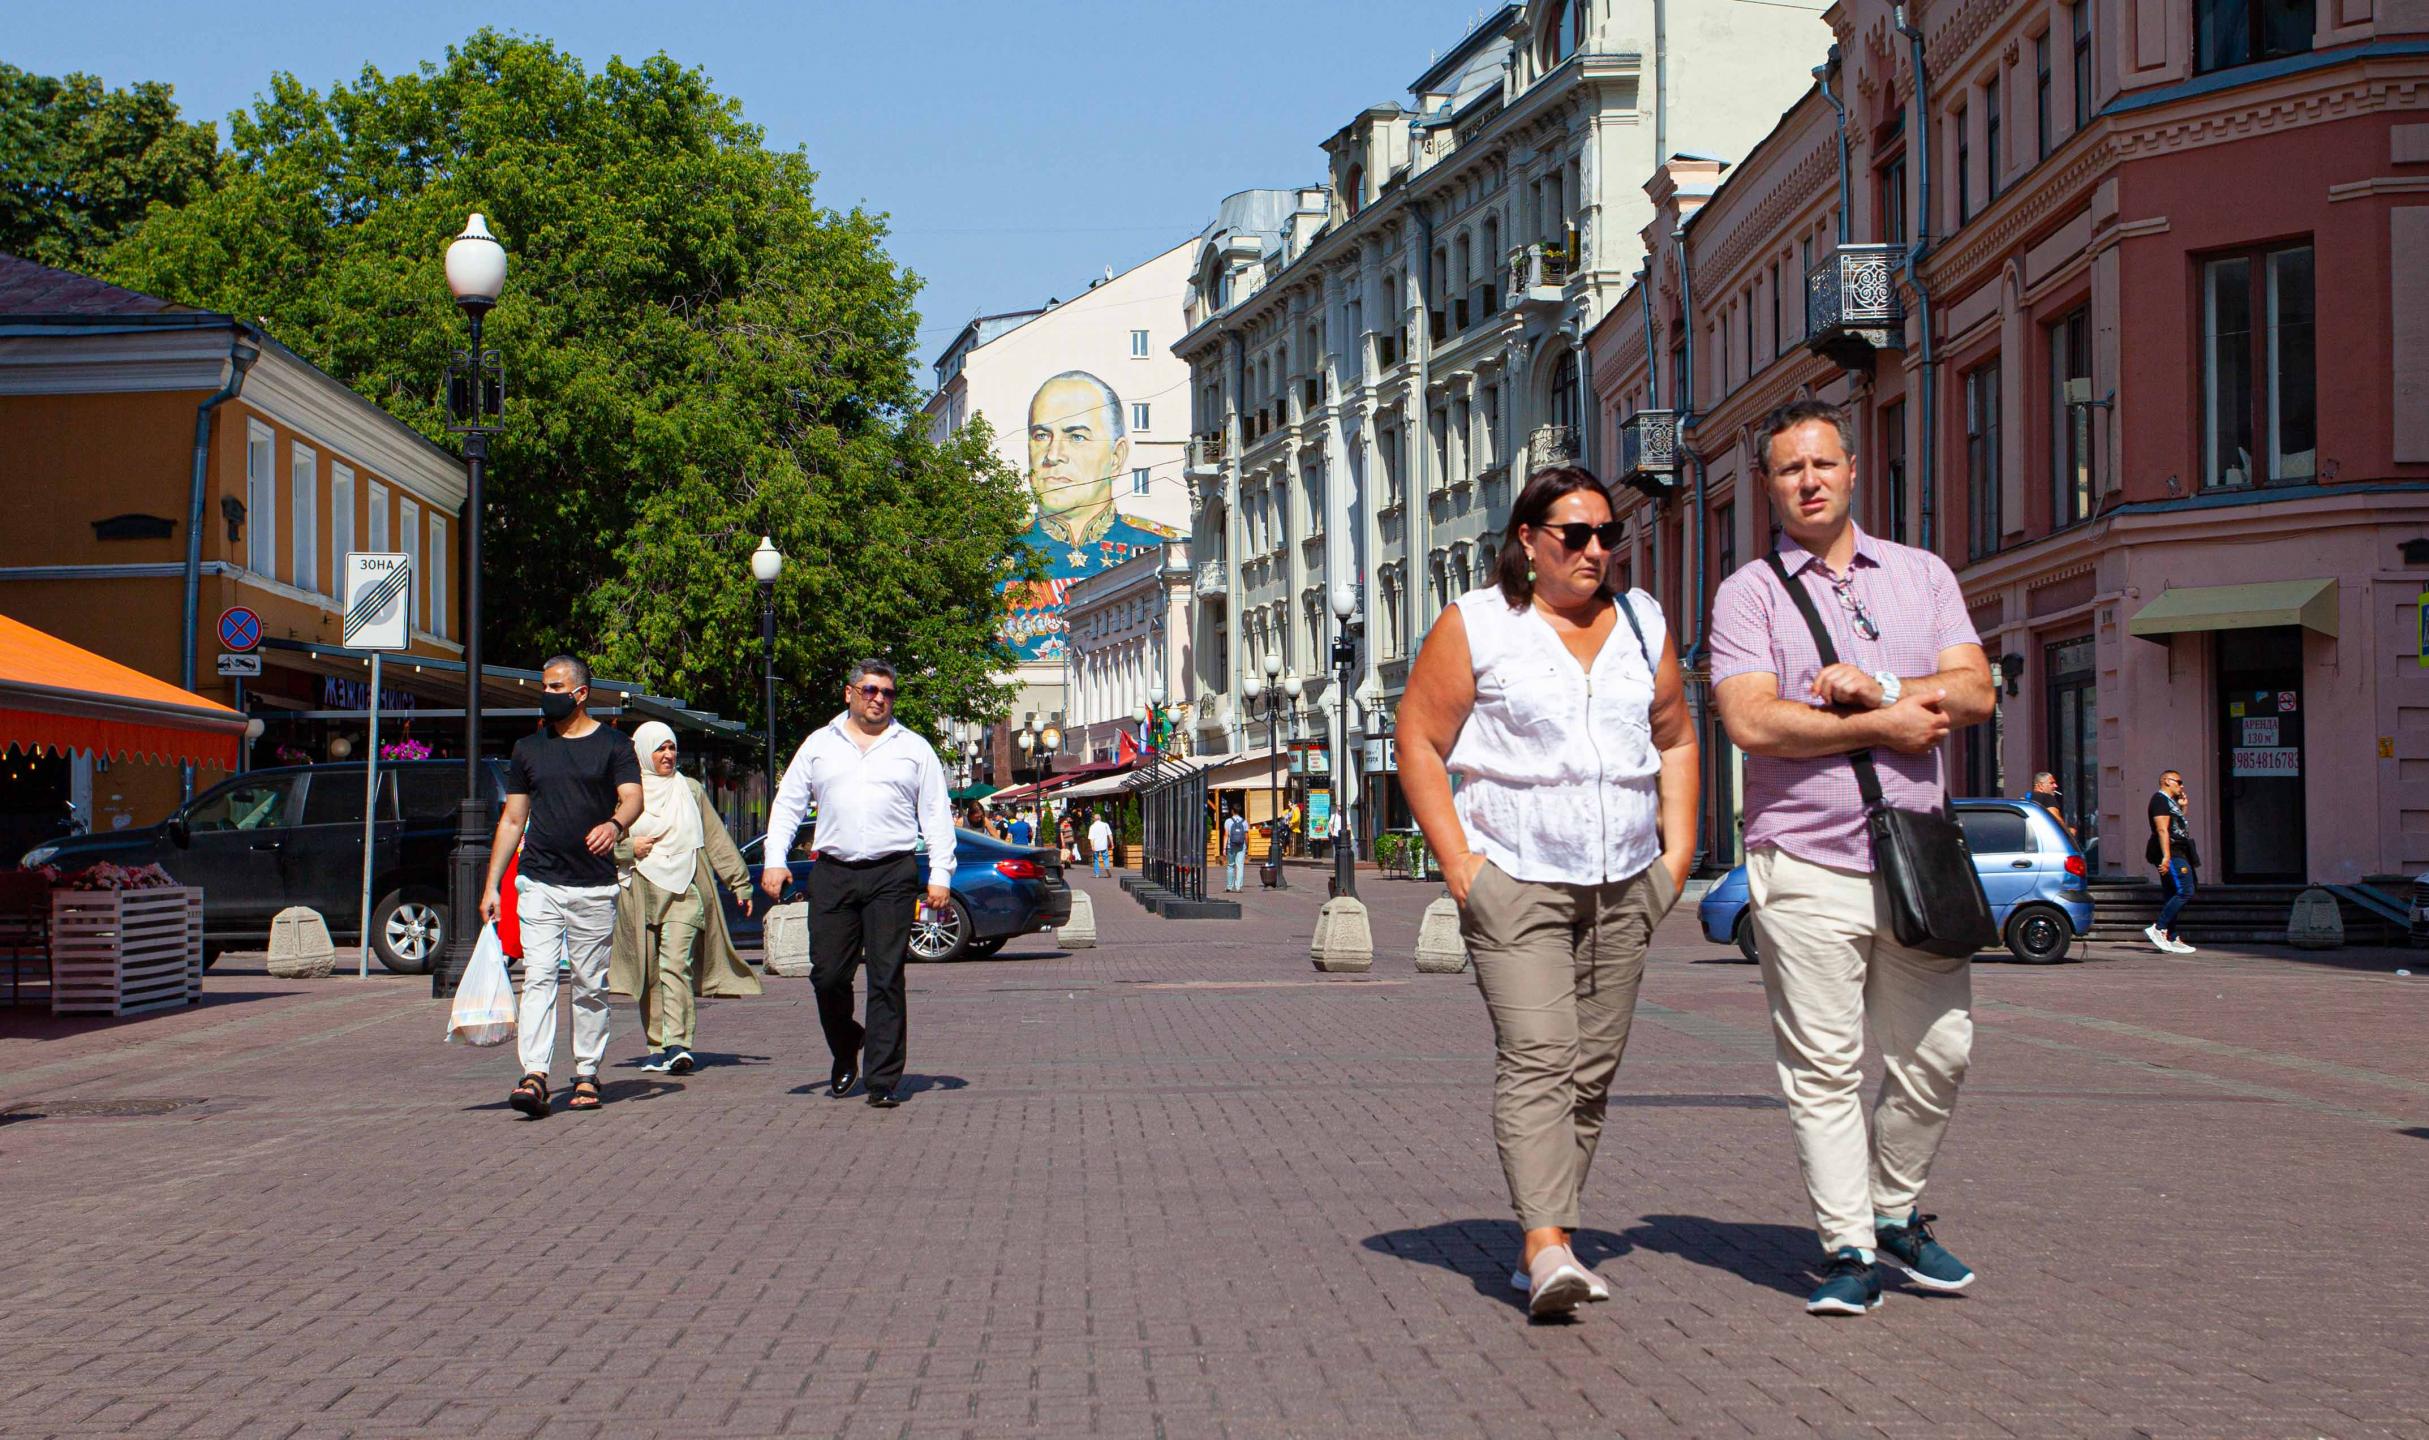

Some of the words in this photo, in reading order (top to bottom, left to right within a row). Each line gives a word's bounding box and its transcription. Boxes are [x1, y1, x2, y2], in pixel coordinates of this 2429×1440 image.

[360, 559, 394, 570] ЗОНА
[2243, 719, 2278, 730] АРЕНДА
[2248, 732, 2263, 744] 130
